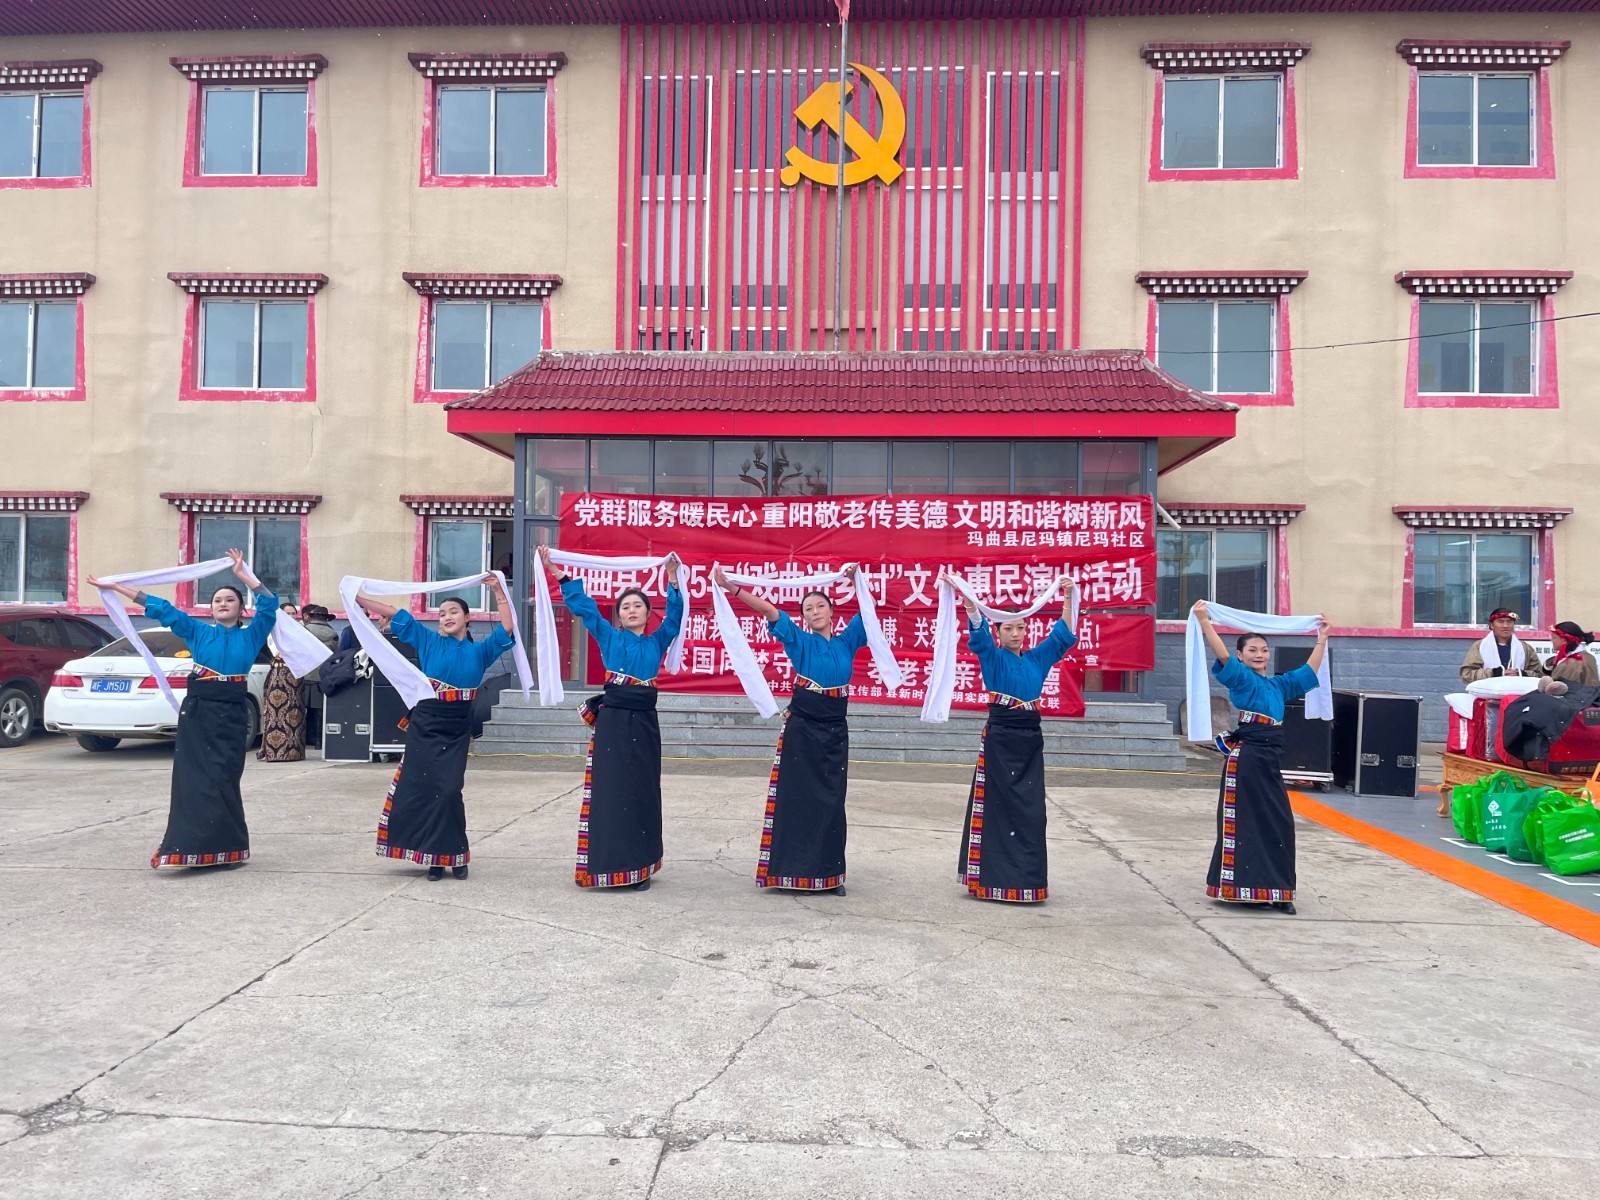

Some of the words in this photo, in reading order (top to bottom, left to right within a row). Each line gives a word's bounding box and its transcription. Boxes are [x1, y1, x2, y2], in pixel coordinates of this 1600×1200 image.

[574, 498, 757, 528] 党群服务暖民心
[762, 499, 948, 529] 重阳敬老传美德
[952, 500, 1145, 530] 文明和谐树新风
[967, 531, 1145, 548] 玛曲县尼玛镇尼玛社区
